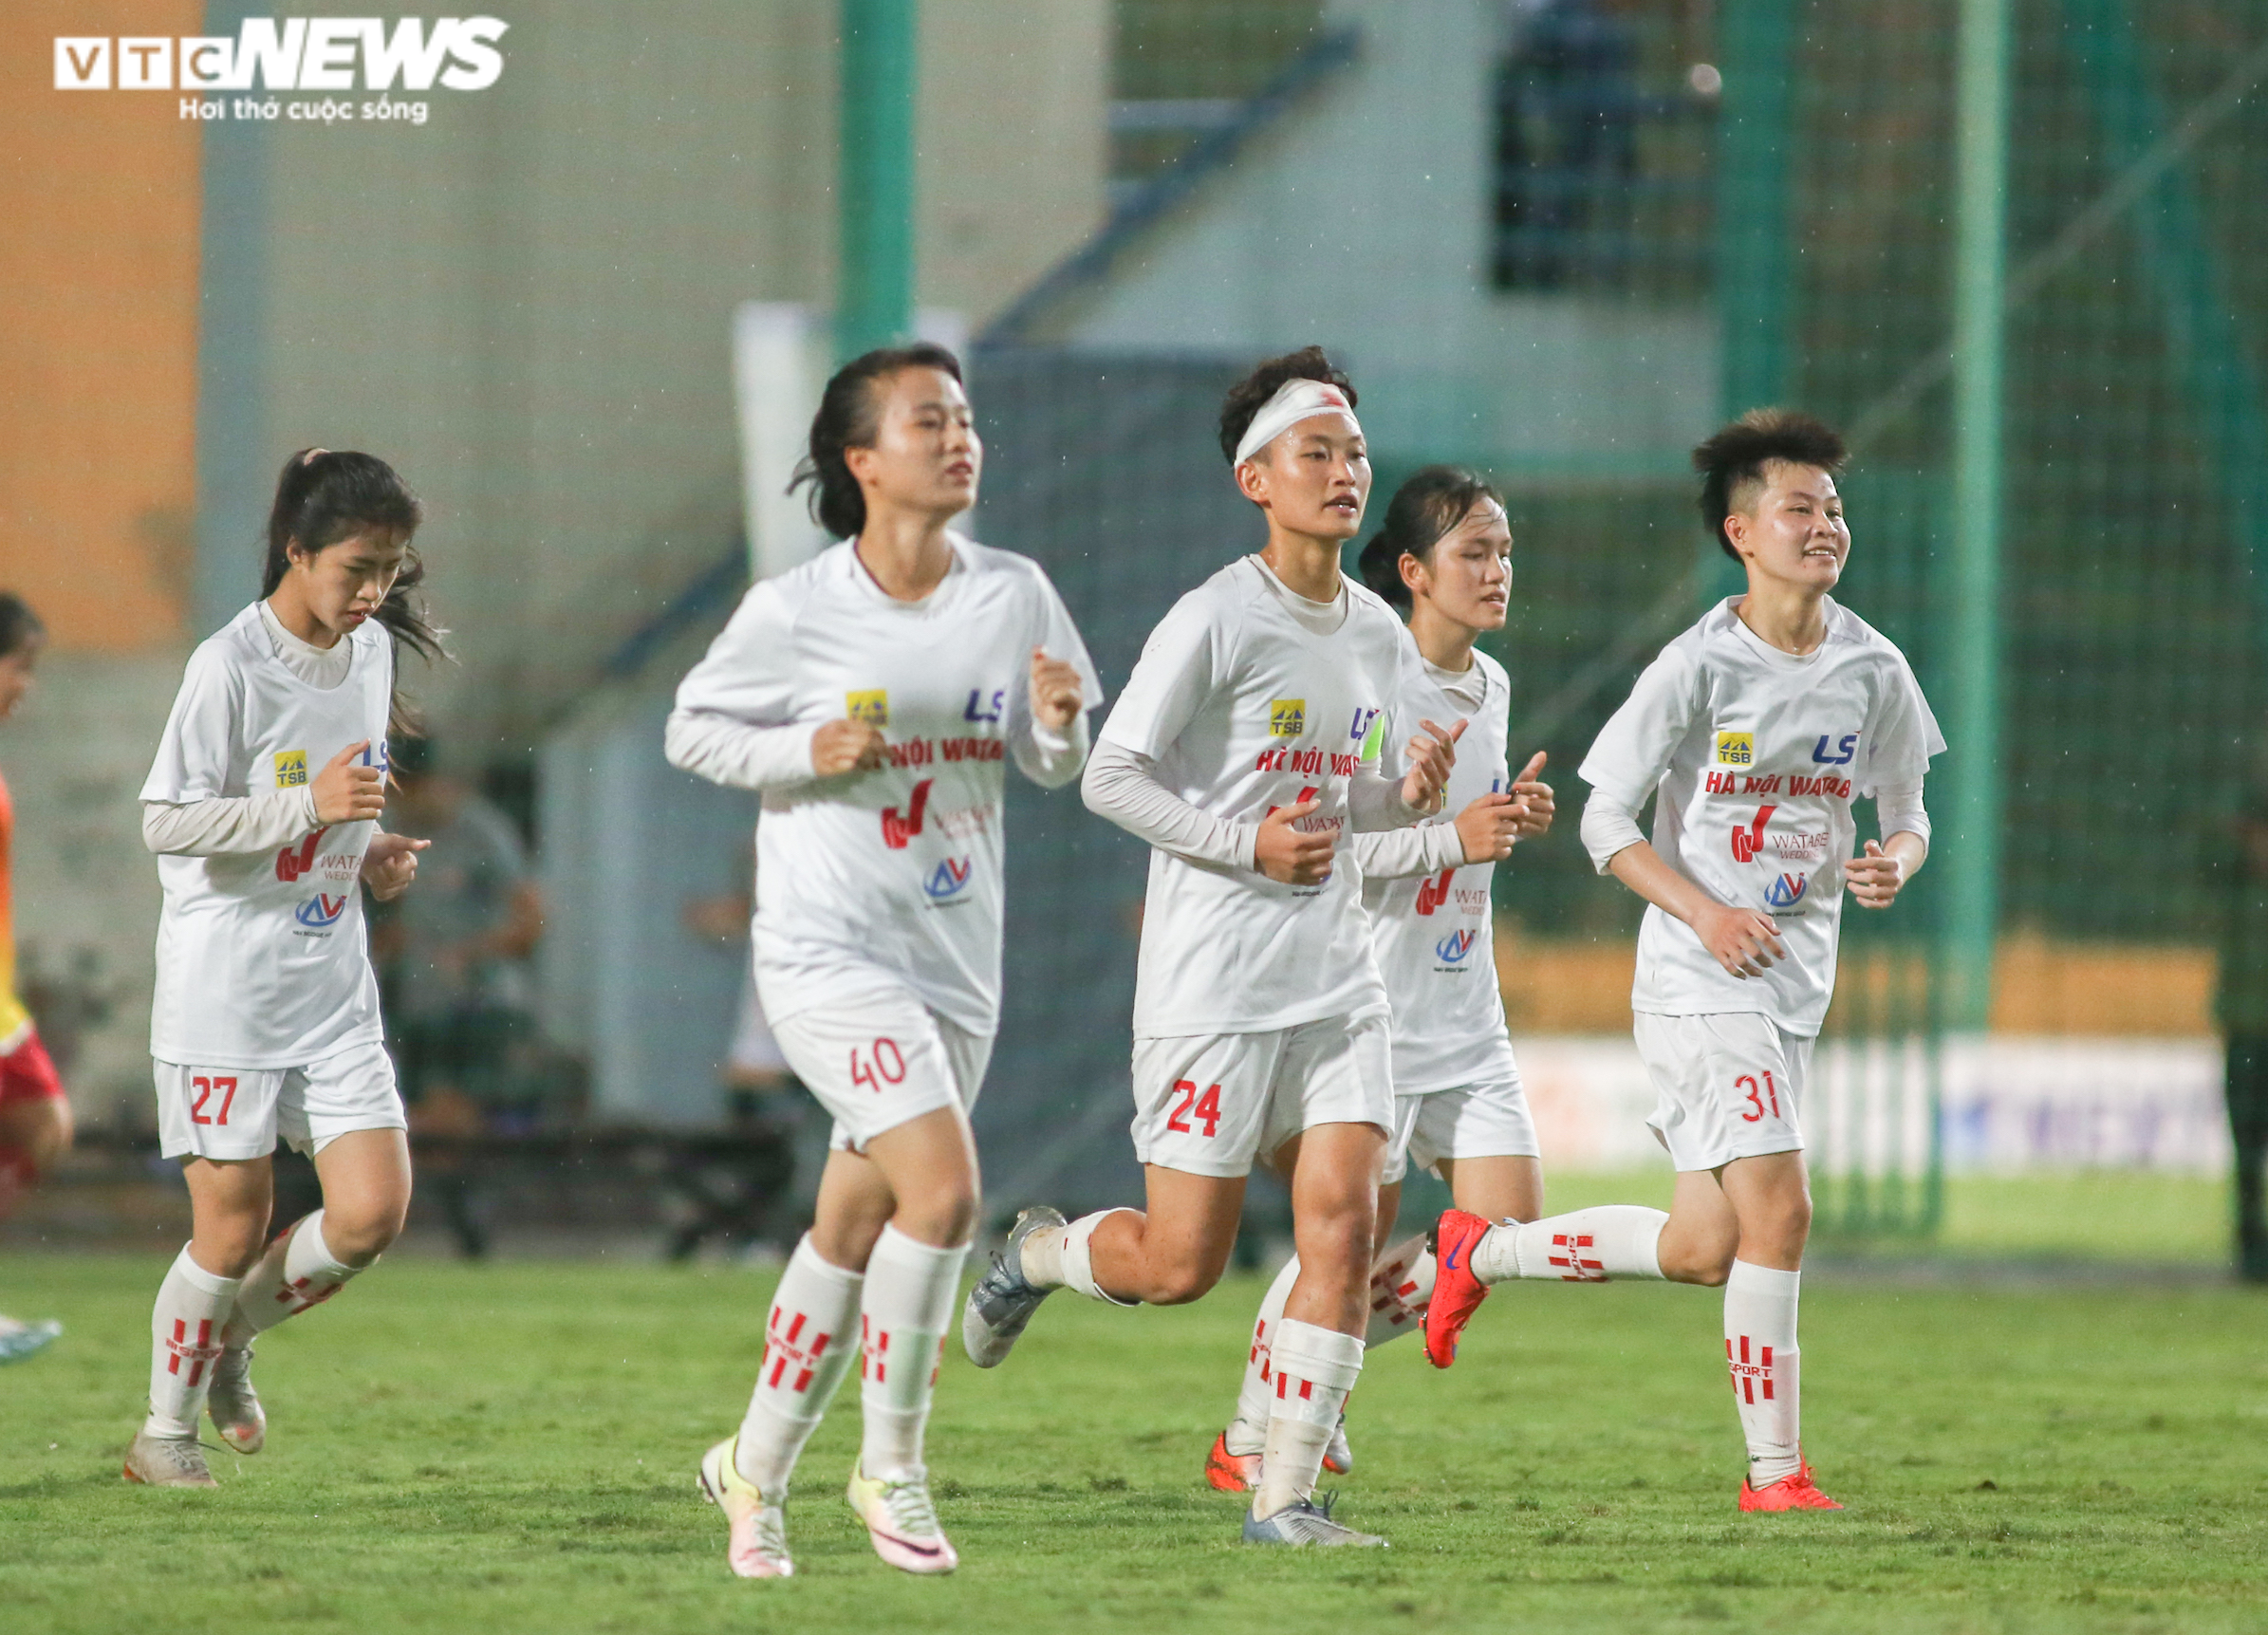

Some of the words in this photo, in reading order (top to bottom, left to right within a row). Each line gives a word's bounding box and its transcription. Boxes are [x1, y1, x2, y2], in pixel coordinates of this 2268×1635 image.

[963, 689, 1004, 722] LS
[1272, 722, 1303, 734] TSB
[1720, 751, 1751, 764] TSB
[1813, 734, 1857, 765] LS
[277, 771, 307, 786] TSB
[1705, 771, 1736, 795] HÀ
[1743, 773, 1783, 798] NỘI
[1773, 832, 1829, 848] WATABE
[850, 1036, 906, 1093] 40
[192, 1076, 238, 1125] 27
[1167, 1079, 1221, 1138] 24
[1734, 1070, 1780, 1123] 31
[1729, 1362, 1773, 1378] SPORT
